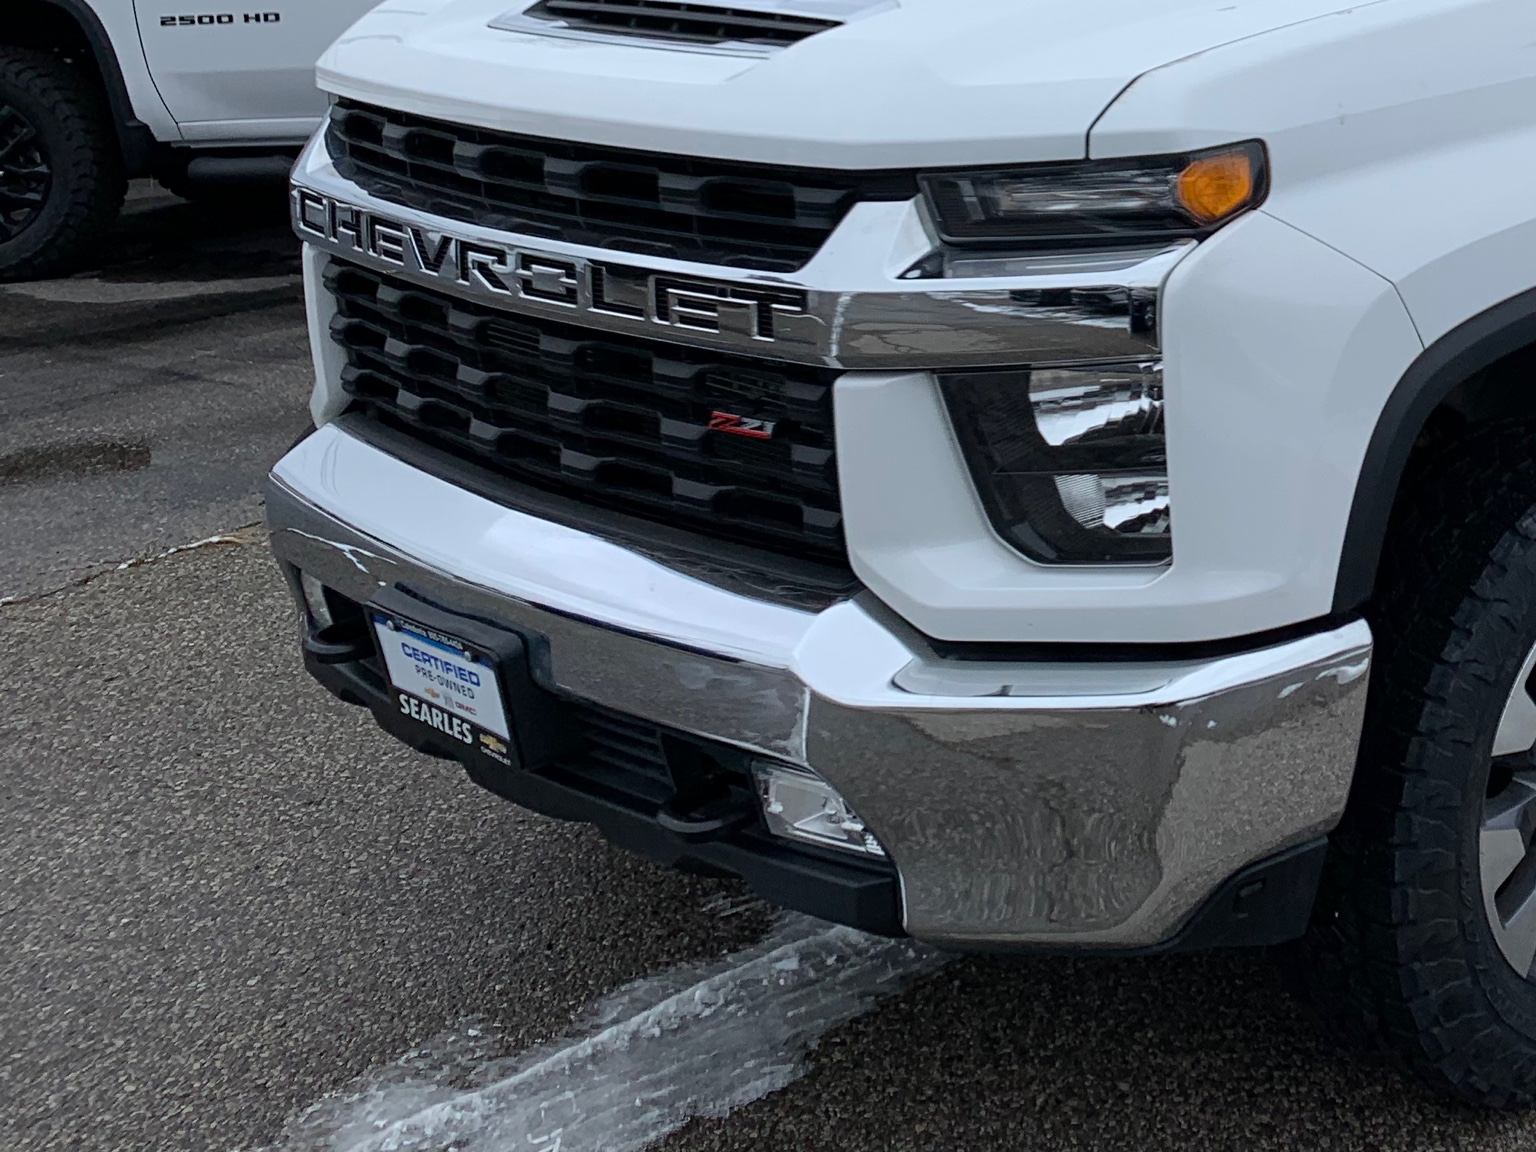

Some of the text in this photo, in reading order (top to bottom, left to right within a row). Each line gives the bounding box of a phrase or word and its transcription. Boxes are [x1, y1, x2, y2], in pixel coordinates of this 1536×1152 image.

[160, 12, 281, 27] 2500 HD
[296, 187, 808, 342] CHEVROLET
[708, 411, 776, 440] Z71
[401, 641, 481, 688] CERTIFIED
[414, 664, 475, 700] PRE-OWNED
[399, 693, 473, 745] SEARLES
